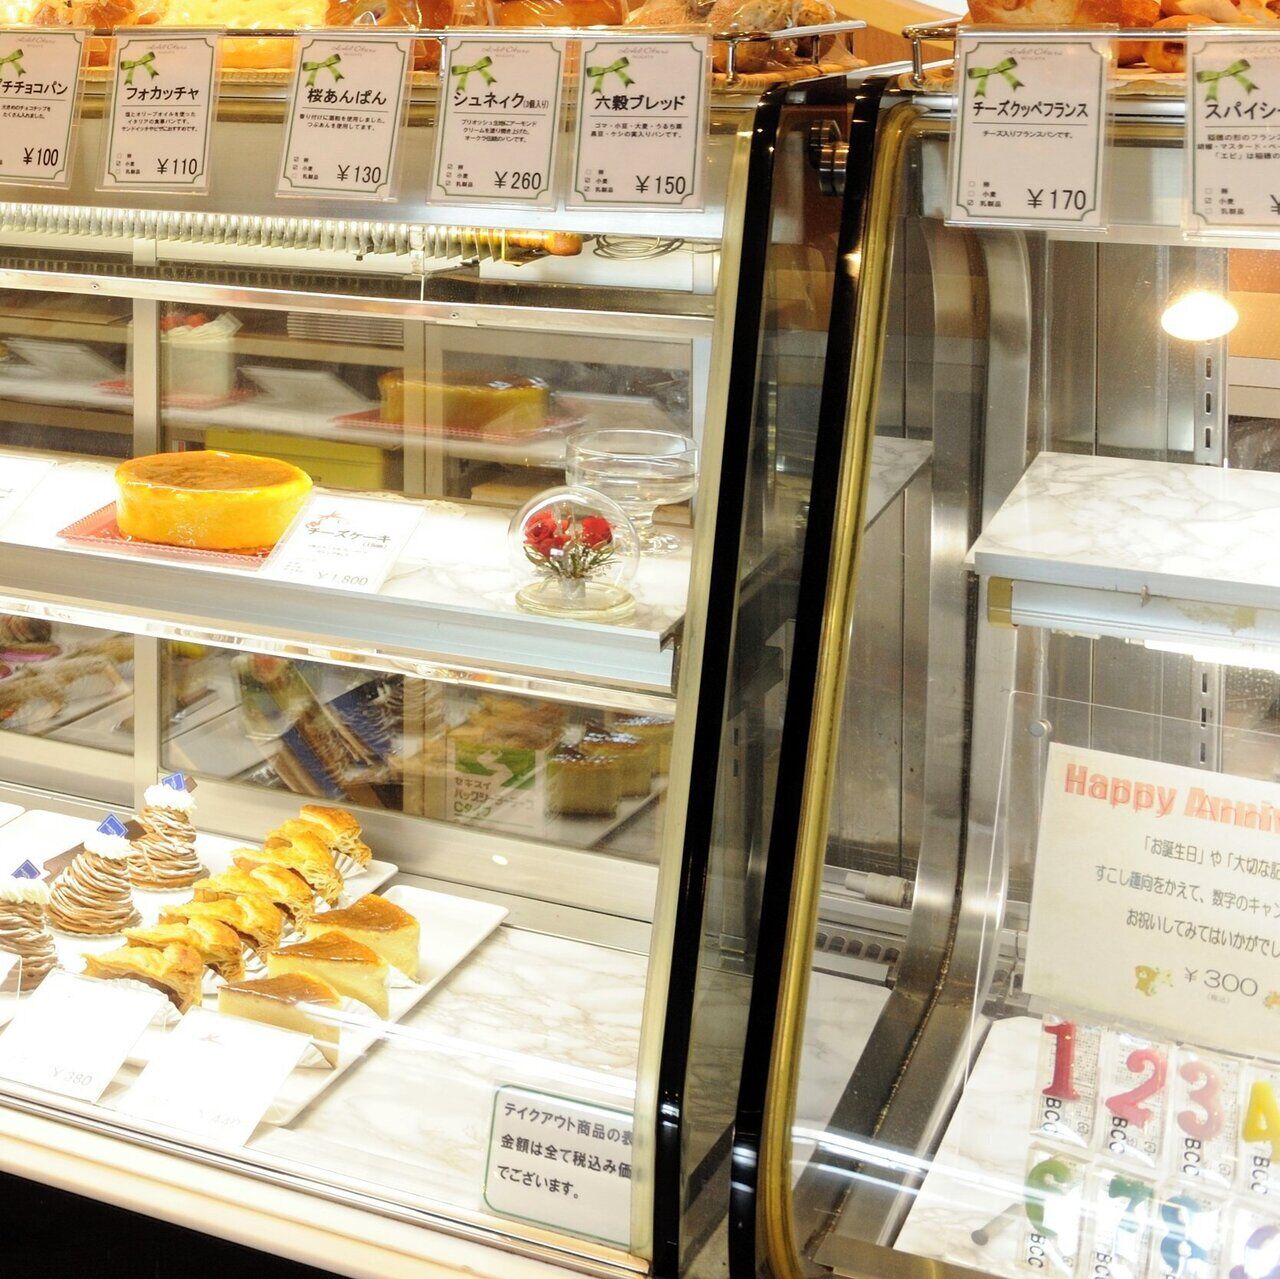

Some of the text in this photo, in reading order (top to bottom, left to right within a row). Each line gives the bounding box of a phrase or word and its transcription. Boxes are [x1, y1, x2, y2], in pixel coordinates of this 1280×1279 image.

[126, 86, 199, 101] フォカッチャ
[307, 88, 387, 106] 桜あんぱん
[595, 95, 686, 111] 六穀ブレッド
[973, 100, 1089, 118] チーズクッペフランス
[1205, 101, 1280, 120] スパイシ
[983, 130, 1073, 139] チーズ入りフランスパンです。
[23, 147, 59, 166] ¥100
[157, 158, 198, 175] ¥110
[337, 164, 381, 184] ¥130
[494, 171, 542, 190] ¥260
[635, 175, 686, 195] ¥150
[1027, 188, 1086, 210] ¥170
[1064, 763, 1280, 832] Happy Anni
[1126, 909, 1280, 958] お祝いしてみてはいかがでし
[1042, 1020, 1080, 1101] 1
[1105, 1048, 1168, 1129] 2
[1177, 1061, 1225, 1141] 3
[504, 1102, 633, 1146] テイクアウト商品の表
[500, 1134, 632, 1180] 金額は全て税込み価
[497, 1165, 579, 1199] でございます。
